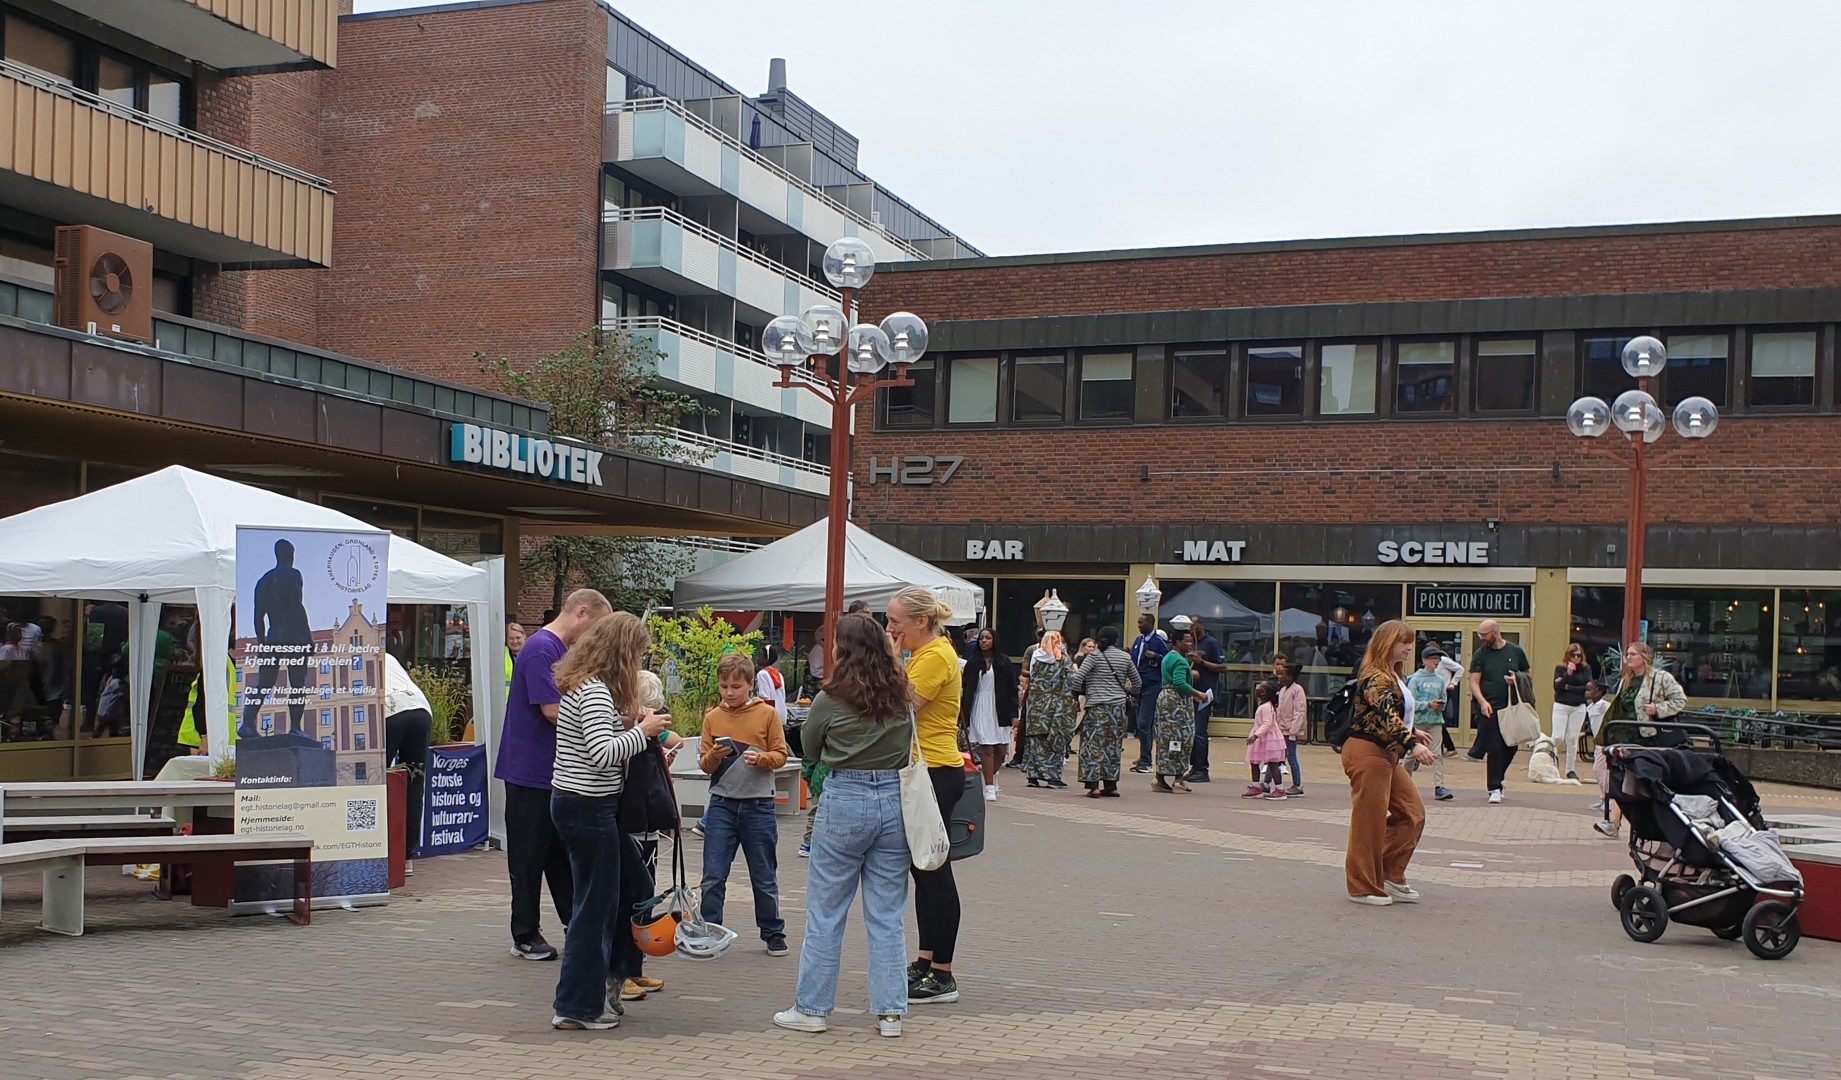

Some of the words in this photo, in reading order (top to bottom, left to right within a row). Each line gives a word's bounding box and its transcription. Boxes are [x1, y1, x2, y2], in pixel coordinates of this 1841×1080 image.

[461, 423, 603, 486] BIBLIOTEK
[869, 456, 965, 485] H27
[966, 540, 1024, 560] BAR
[1183, 540, 1246, 561] MAT
[1377, 540, 1489, 563] SCENE
[335, 582, 372, 594] HISTORIELAG
[1420, 592, 1520, 611] POSTKONTORET
[244, 643, 312, 653] Interessert
[314, 643, 319, 653] i
[320, 643, 328, 653] å
[331, 643, 346, 653] bli
[348, 644, 380, 653] bedre
[244, 656, 277, 668] kjent
[278, 656, 305, 666] med
[307, 656, 360, 668] bydelen?
[244, 686, 259, 695] Da
[260, 687, 272, 695] er
[273, 686, 335, 696] Historielaget
[336, 686, 346, 694] et
[348, 686, 377, 696] veldig
[244, 697, 262, 706] bra
[263, 696, 313, 706] alternativ.
[240, 775, 293, 785] Kontaktinfo:
[431, 772, 463, 788] største
[240, 795, 261, 803] Mail:
[431, 790, 466, 807] historie
[469, 791, 482, 806] og
[240, 801, 337, 812] egt.historielag@gmail.com
[240, 815, 295, 825] Hjemmeside:
[431, 810, 480, 827] kulturarv-
[240, 824, 305, 834] egt-historielag.no
[431, 828, 465, 846] festival
[312, 841, 382, 850] ok.com/EGTHistorie
